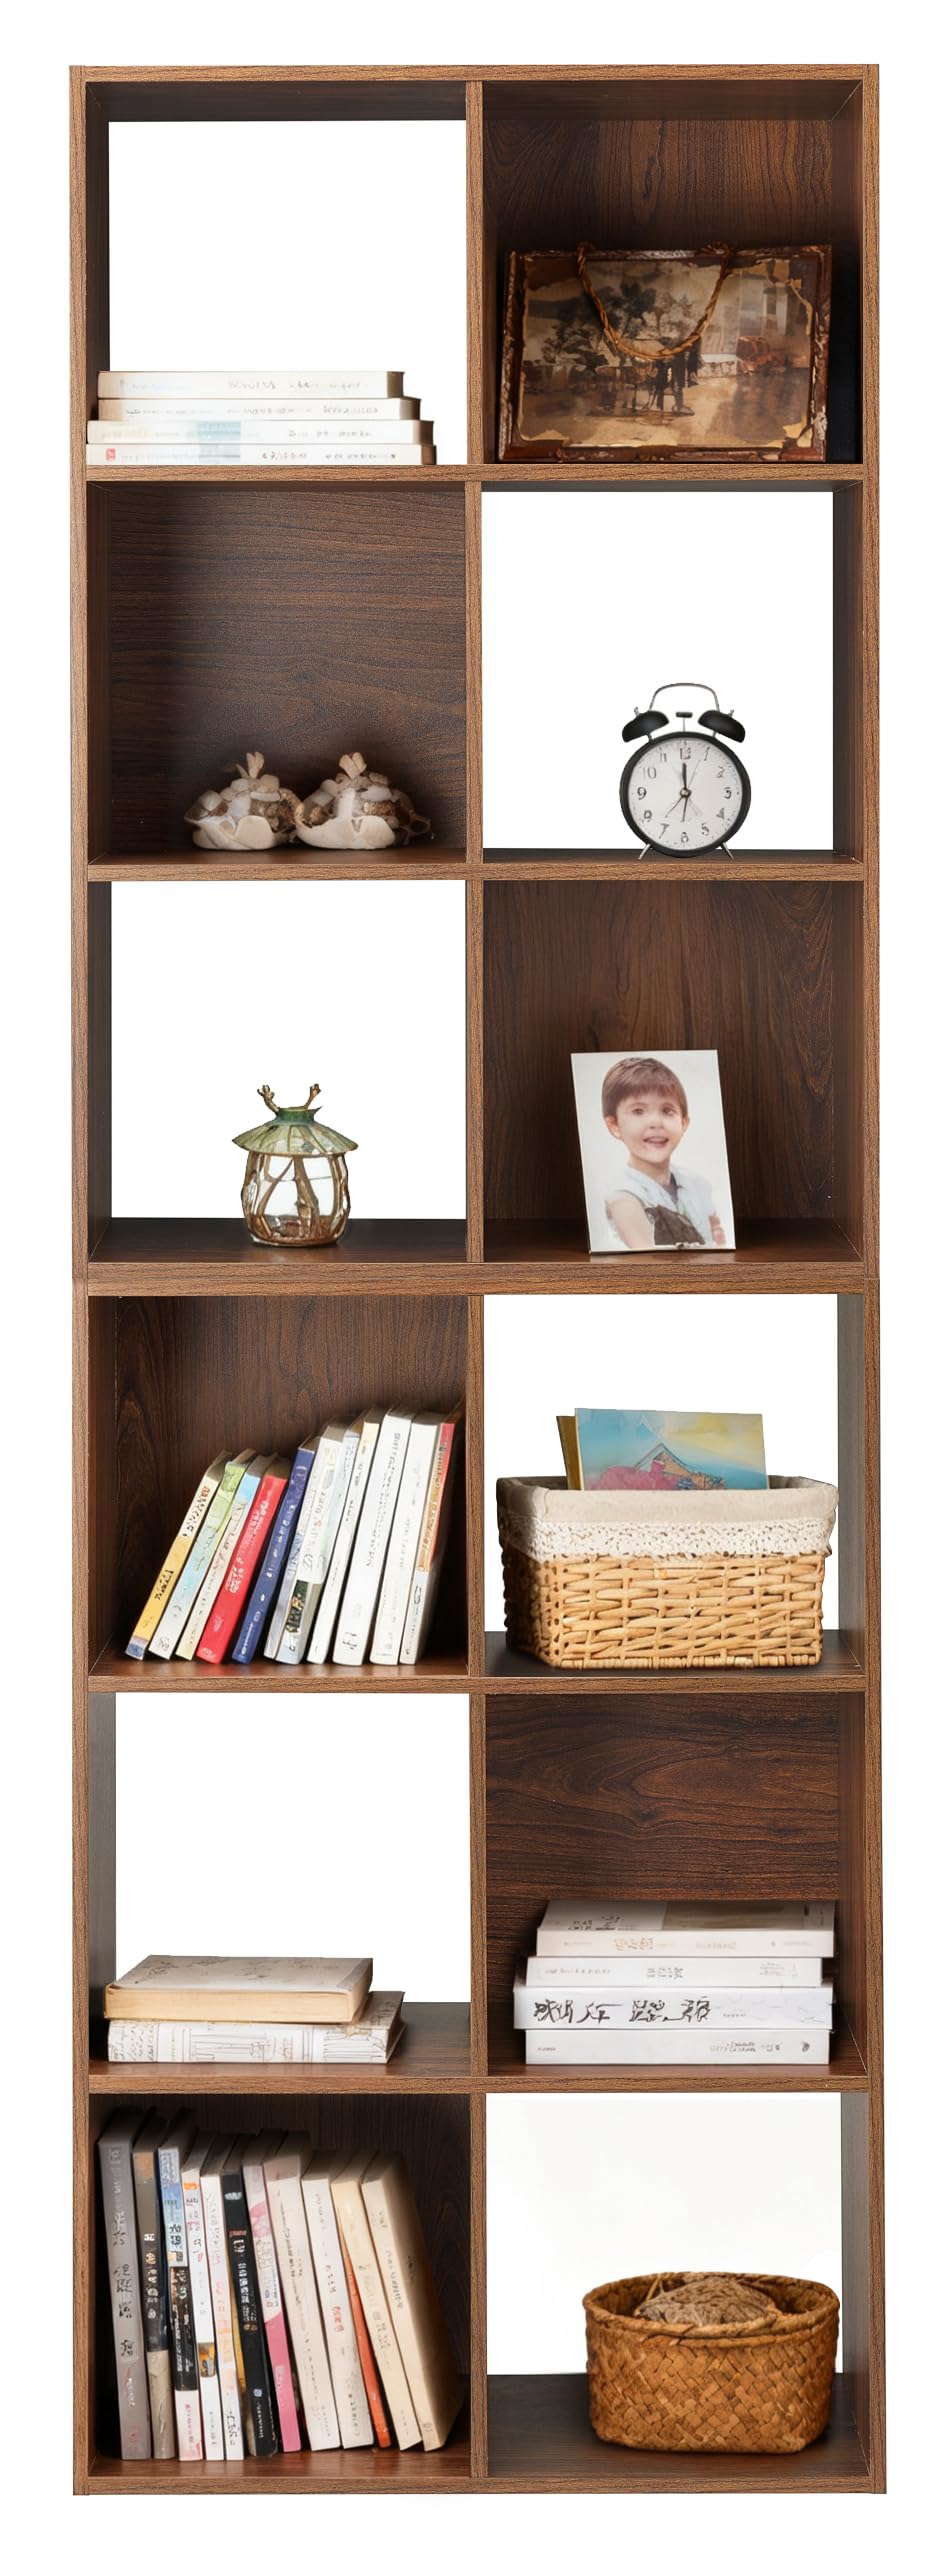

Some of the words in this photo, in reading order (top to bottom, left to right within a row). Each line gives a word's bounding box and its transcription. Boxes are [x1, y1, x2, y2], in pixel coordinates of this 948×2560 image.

[704, 746, 711, 761] 1
[643, 767, 657, 779] 10
[716, 766, 725, 778] 2
[637, 787, 647, 800] 9
[659, 823, 670, 839] 7
[701, 822, 710, 836] 5
